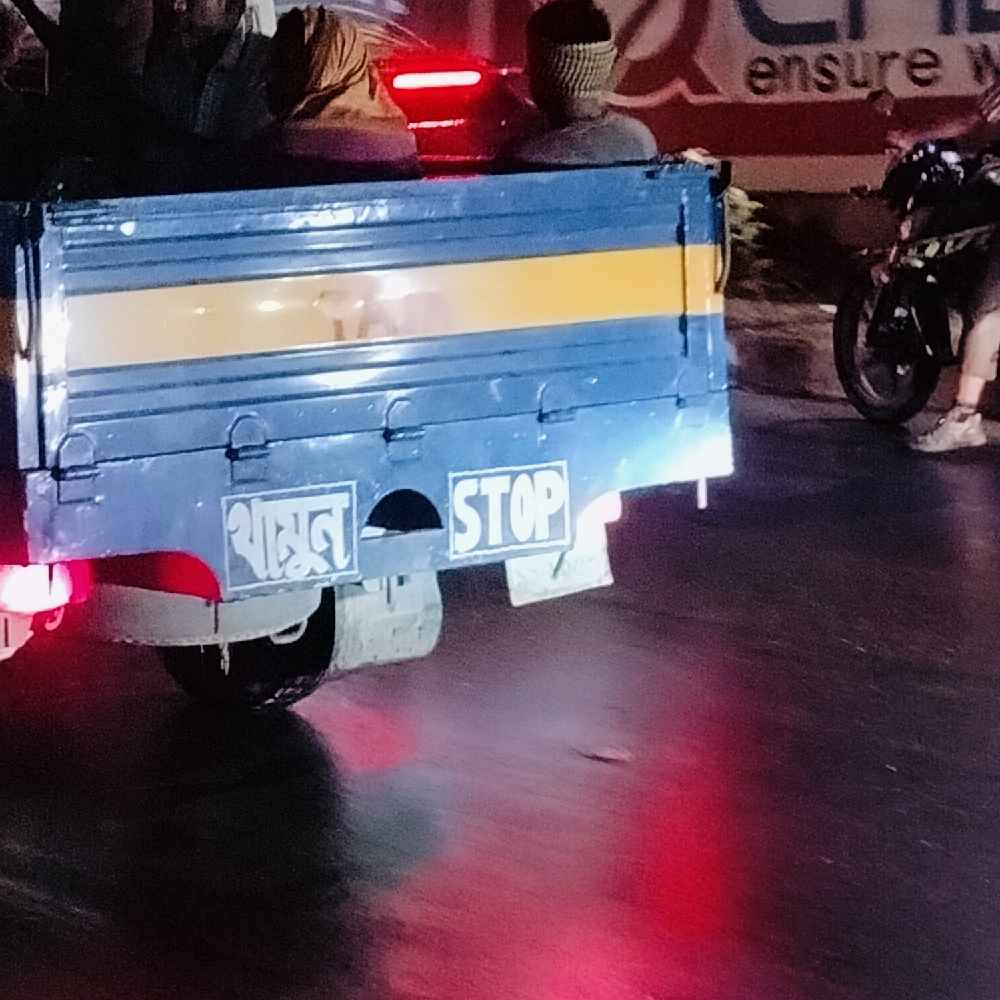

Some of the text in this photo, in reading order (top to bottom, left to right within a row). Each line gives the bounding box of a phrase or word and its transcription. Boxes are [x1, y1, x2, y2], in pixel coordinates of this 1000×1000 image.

[745, 48, 942, 96] ensure
[227, 491, 351, 580] থামুন
[453, 469, 566, 553] STOP
